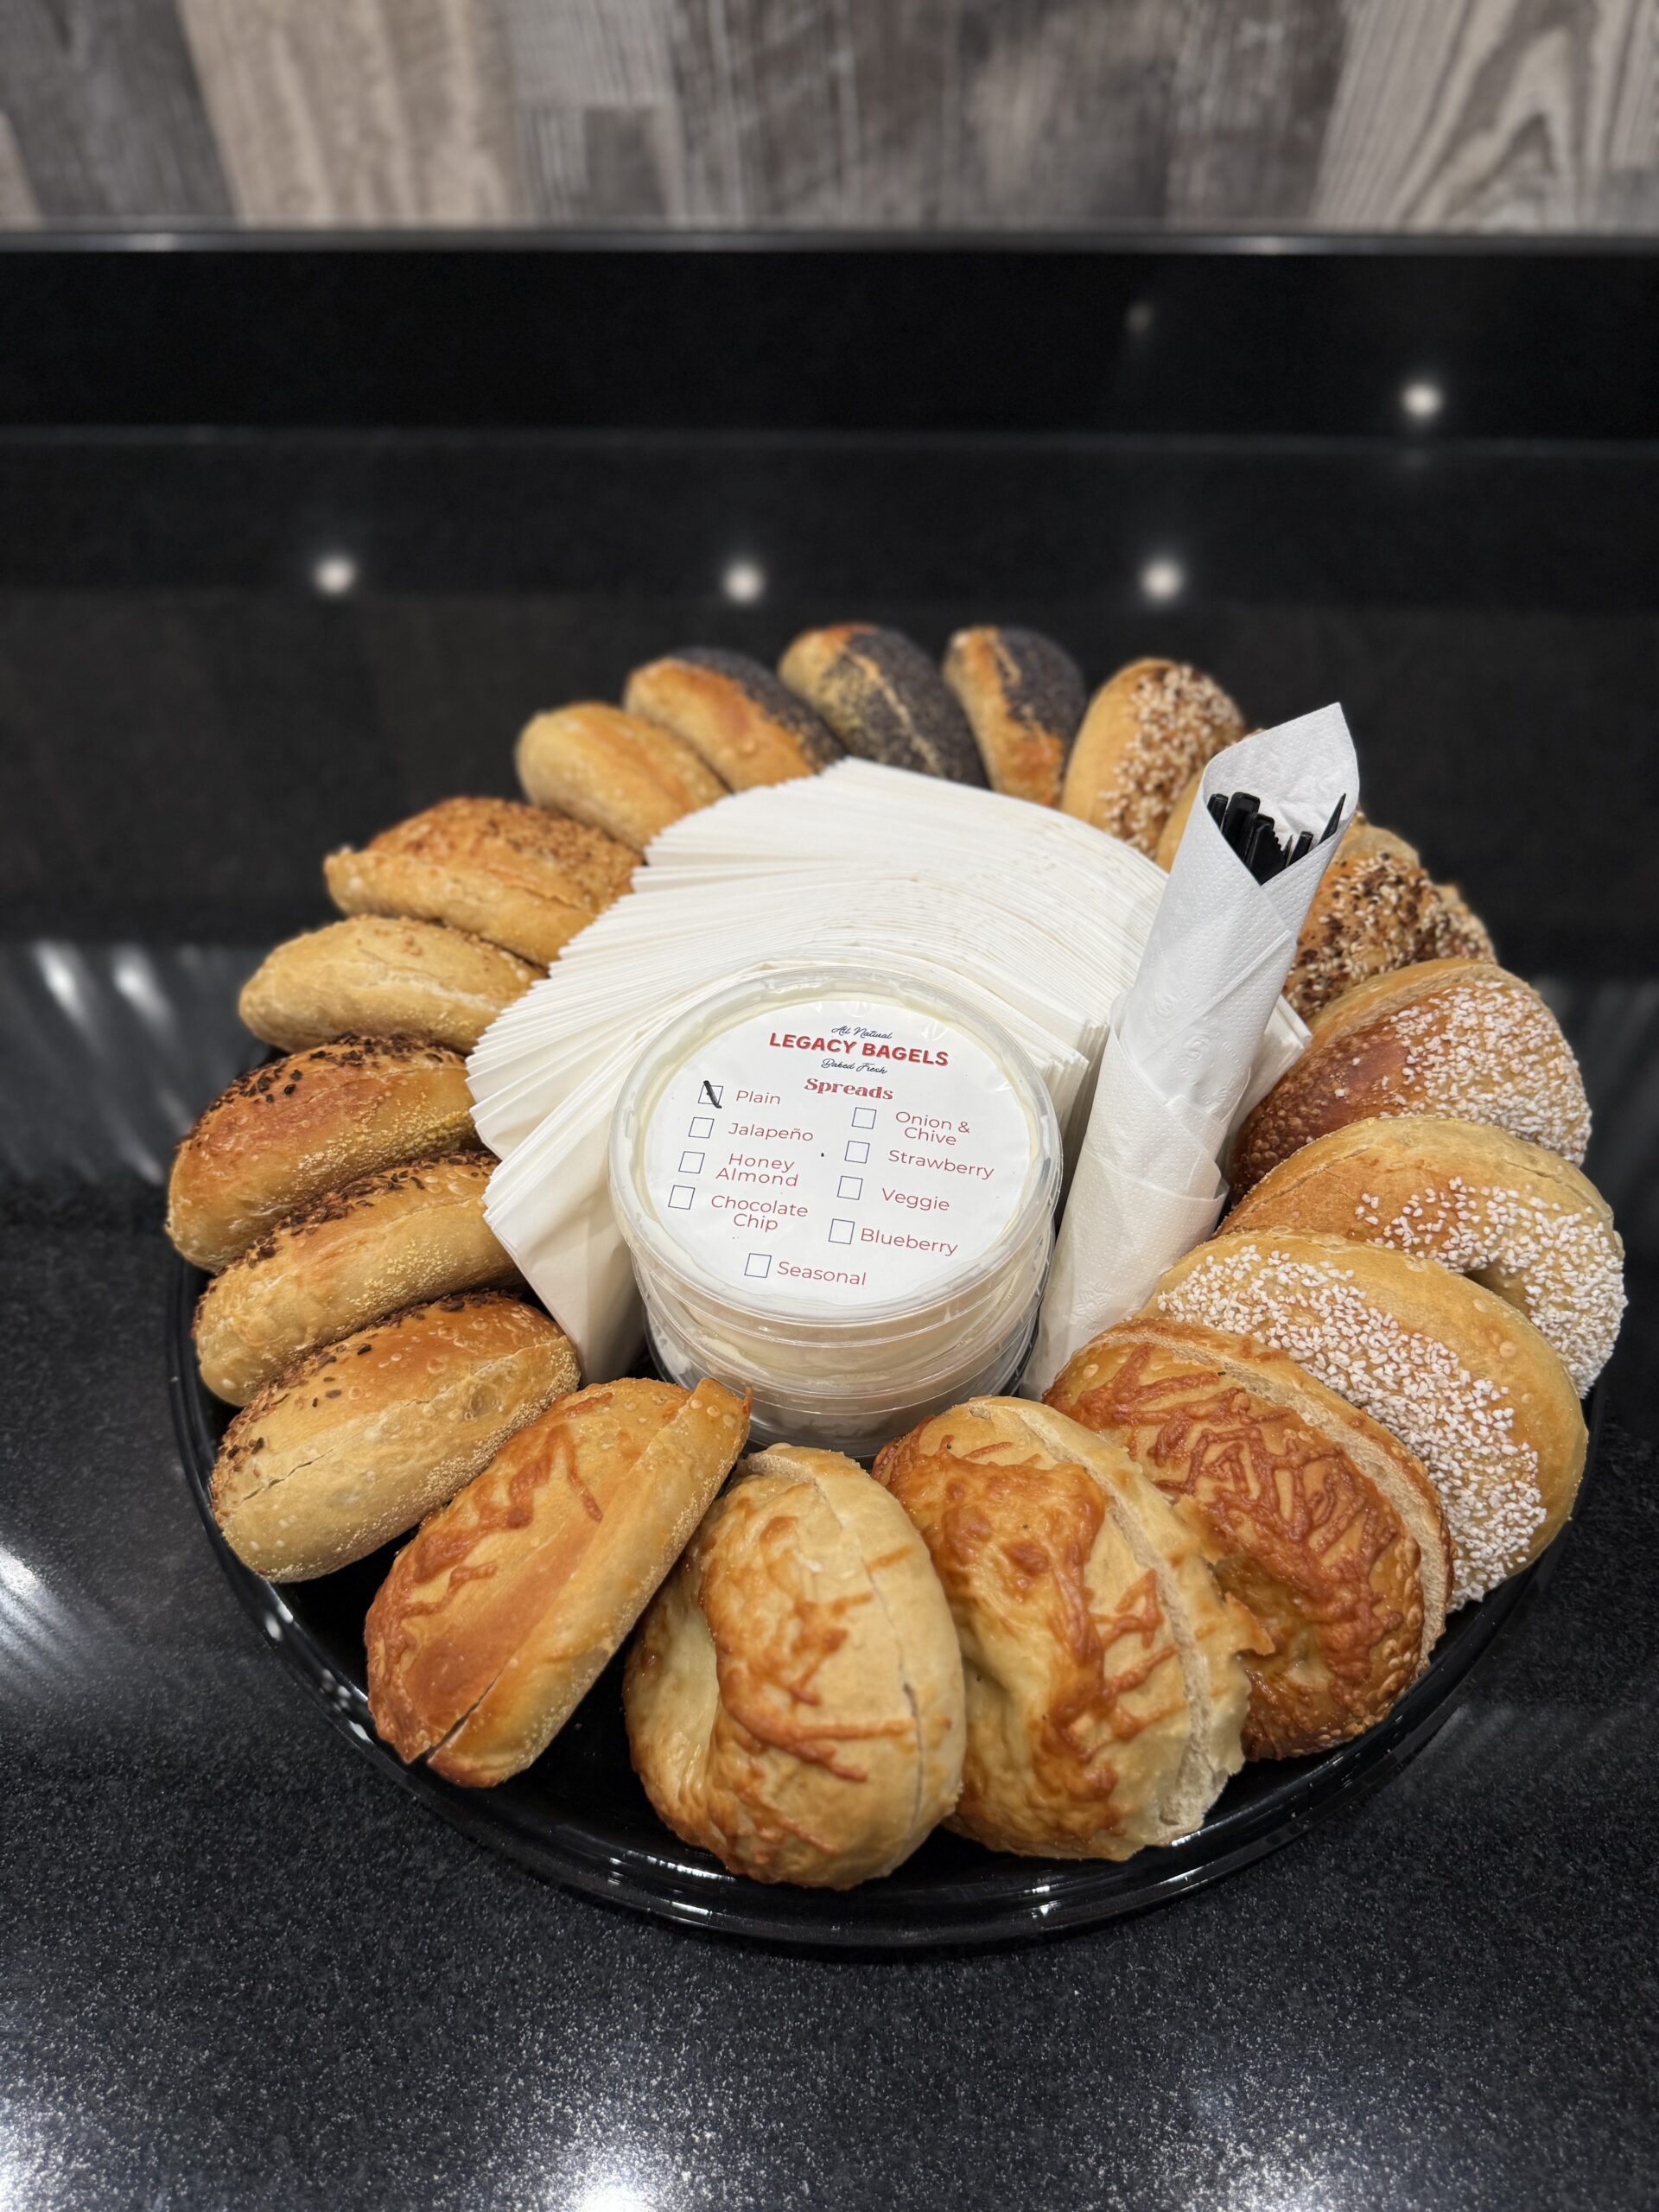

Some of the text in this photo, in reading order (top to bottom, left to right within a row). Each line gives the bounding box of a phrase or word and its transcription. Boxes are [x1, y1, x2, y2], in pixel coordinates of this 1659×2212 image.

[832, 1026, 893, 1040] All Natural
[769, 1033, 950, 1066] LEGACY BAGELS
[821, 1058, 887, 1075] Baked Fresh
[736, 1090, 781, 1105] Plain
[804, 1077, 893, 1101] Spreads
[728, 1122, 814, 1142] Jalapeño
[895, 1111, 970, 1134] Onion &
[905, 1127, 957, 1146] Chive
[728, 1153, 795, 1173] Honey
[888, 1149, 995, 1181] Strawberry
[715, 1167, 798, 1186] Almond
[711, 1195, 808, 1218] Chocolate
[881, 1188, 950, 1212] Veggie
[733, 1214, 779, 1233] Chip
[861, 1228, 958, 1256] Blueberry
[777, 1262, 867, 1286] Seasonal
